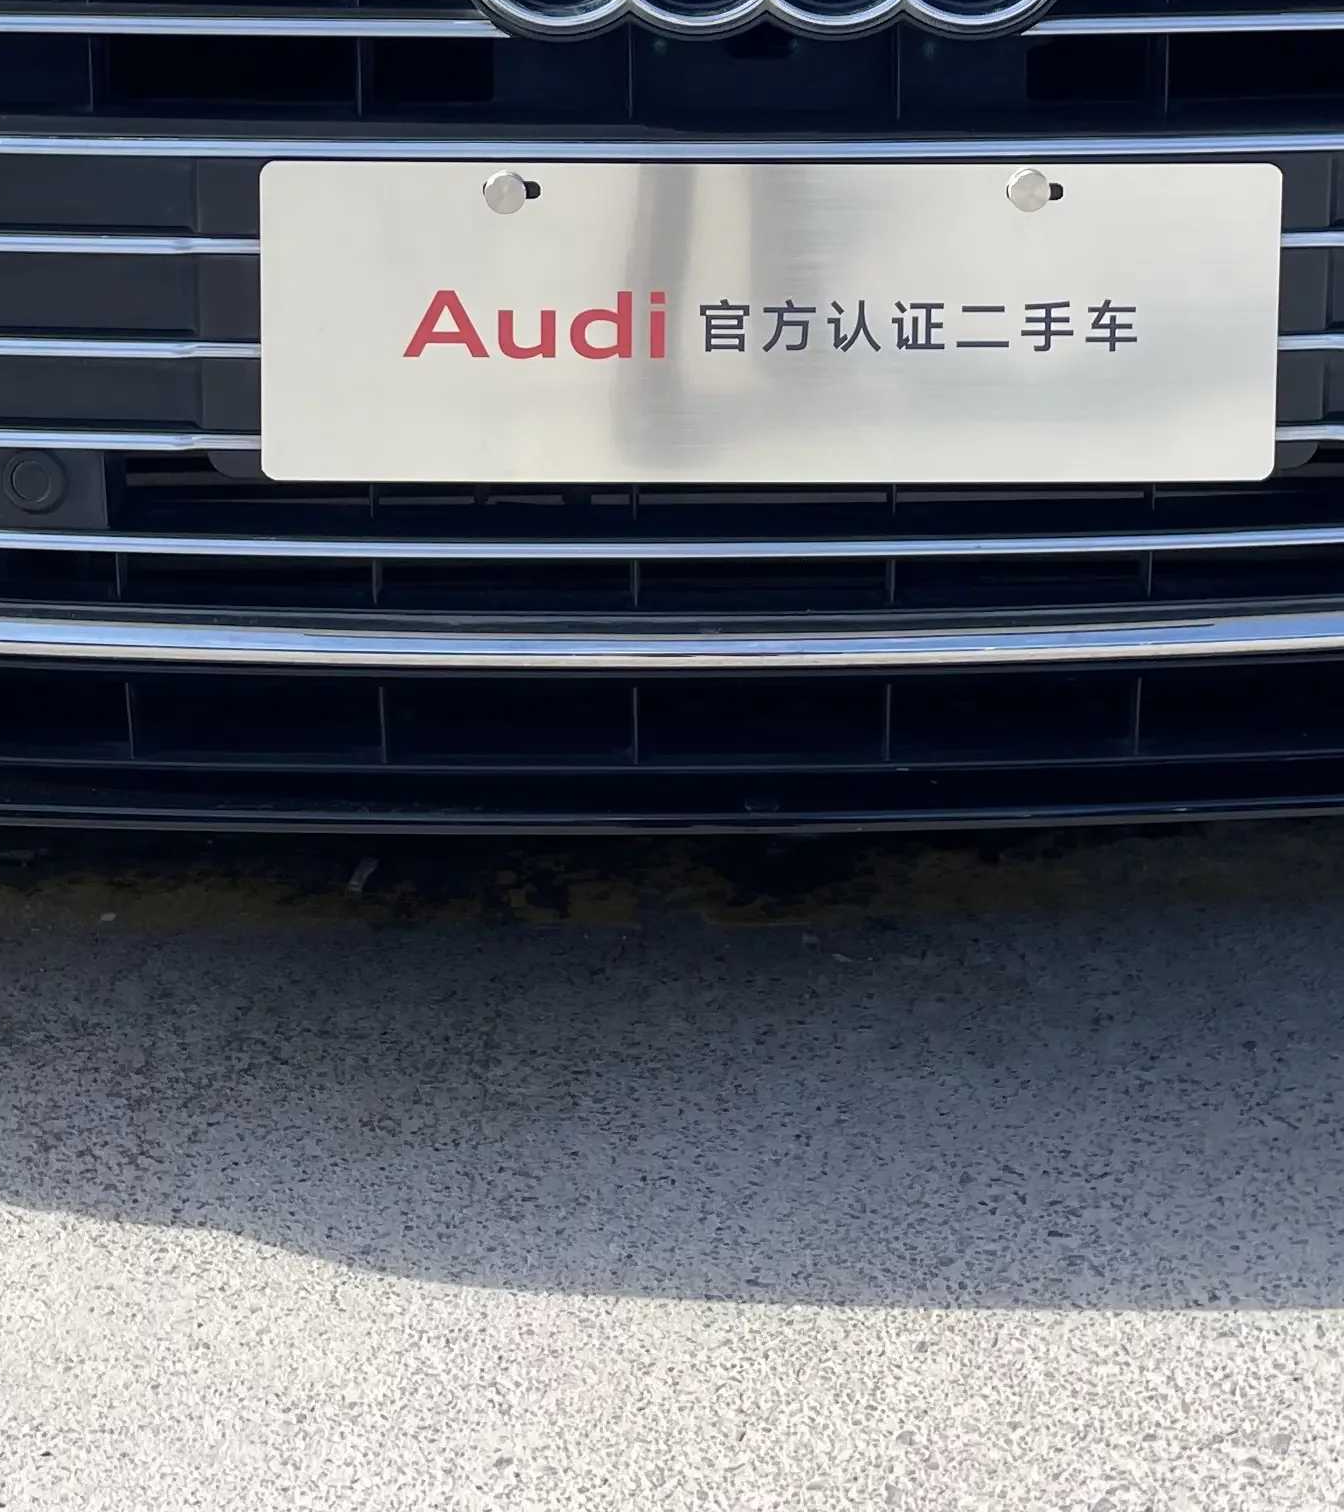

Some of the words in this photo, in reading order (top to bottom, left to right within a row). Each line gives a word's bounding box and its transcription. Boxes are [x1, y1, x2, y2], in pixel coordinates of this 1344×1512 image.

[402, 290, 667, 360] Audi
[698, 298, 1140, 354] 官方认证二手车
